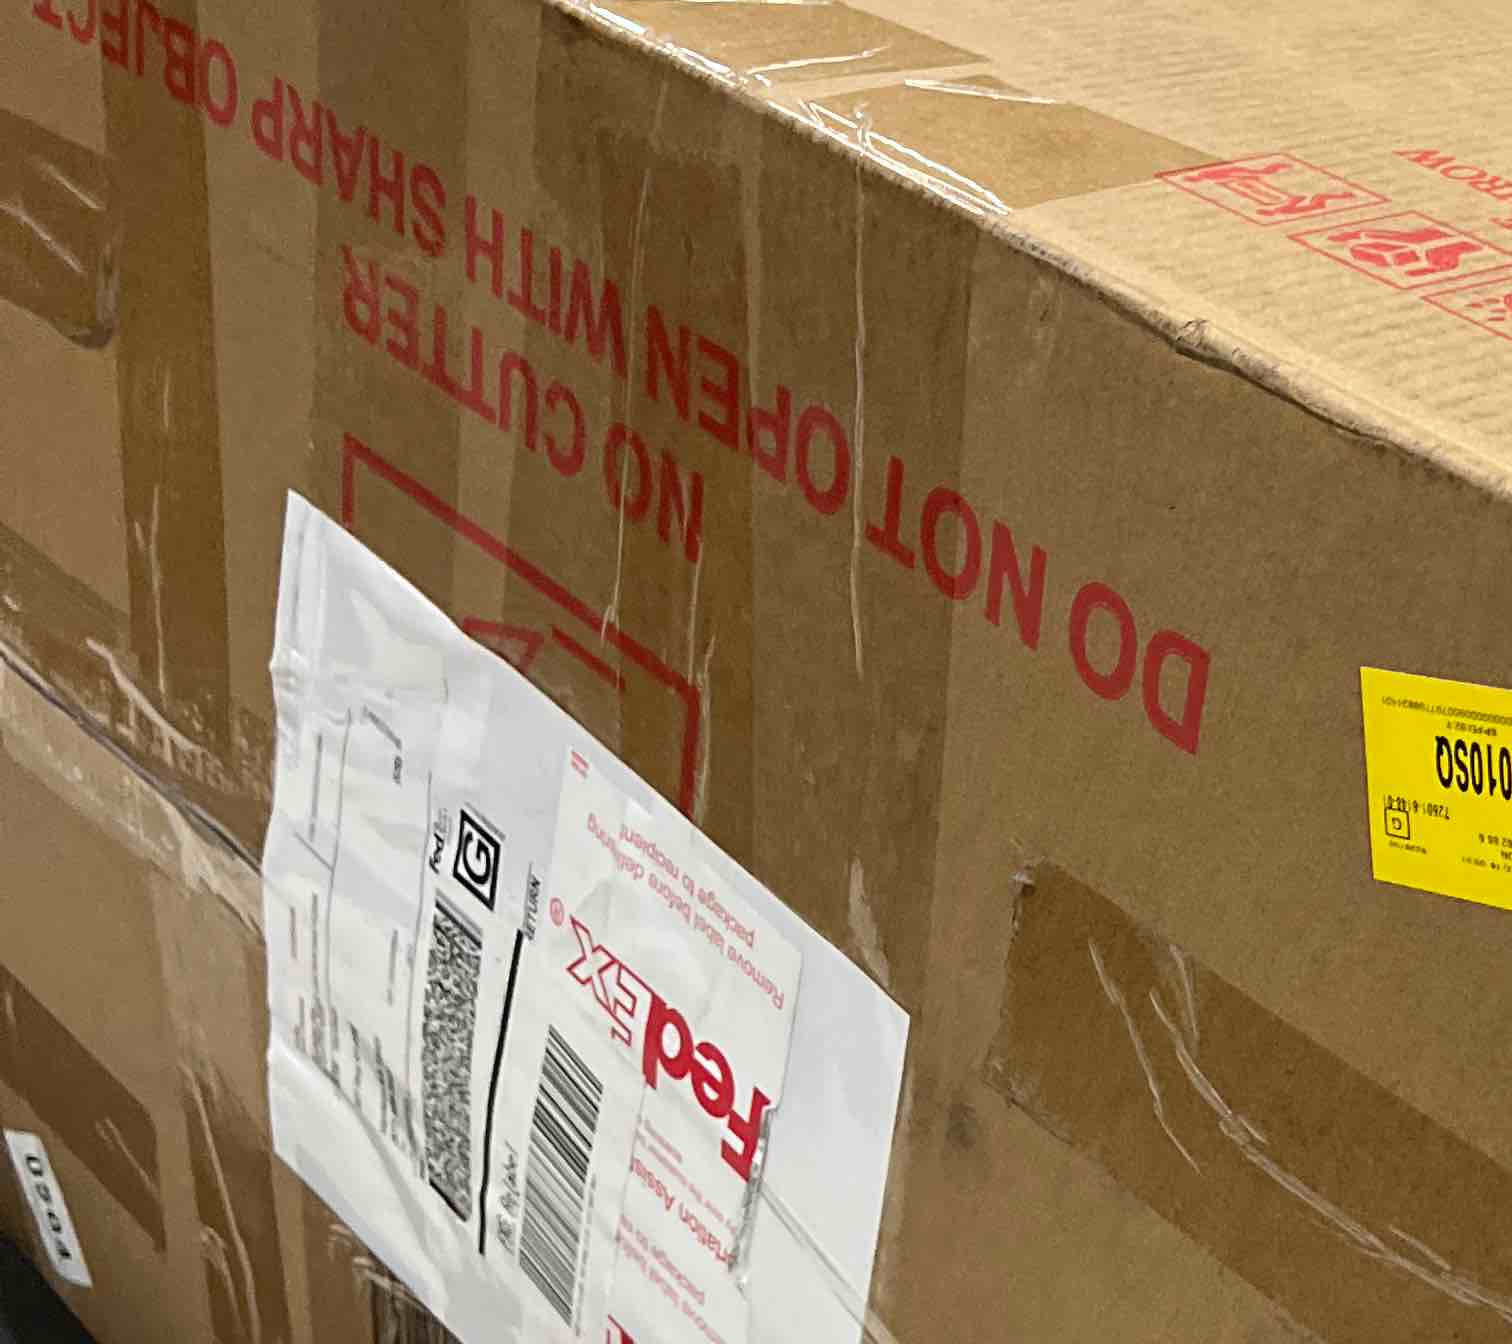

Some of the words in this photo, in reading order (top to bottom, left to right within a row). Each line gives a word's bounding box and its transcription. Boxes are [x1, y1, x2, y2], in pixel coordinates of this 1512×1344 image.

[250, 75, 449, 259] SHARP
[463, 194, 631, 378] WITH
[340, 244, 588, 478] CUTTER
[644, 304, 852, 516] OPEN
[604, 421, 704, 563] NO
[865, 456, 1048, 652] NOT
[1068, 581, 1211, 755] DO
[466, 834, 491, 889] G
[619, 823, 681, 882] recipient
[1390, 815, 1402, 831] G
[648, 873, 696, 921] before
[682, 872, 697, 897] to
[694, 912, 727, 958] label
[697, 883, 758, 949] package
[727, 943, 785, 1010] Remove
[566, 914, 774, 1182] FedEx
